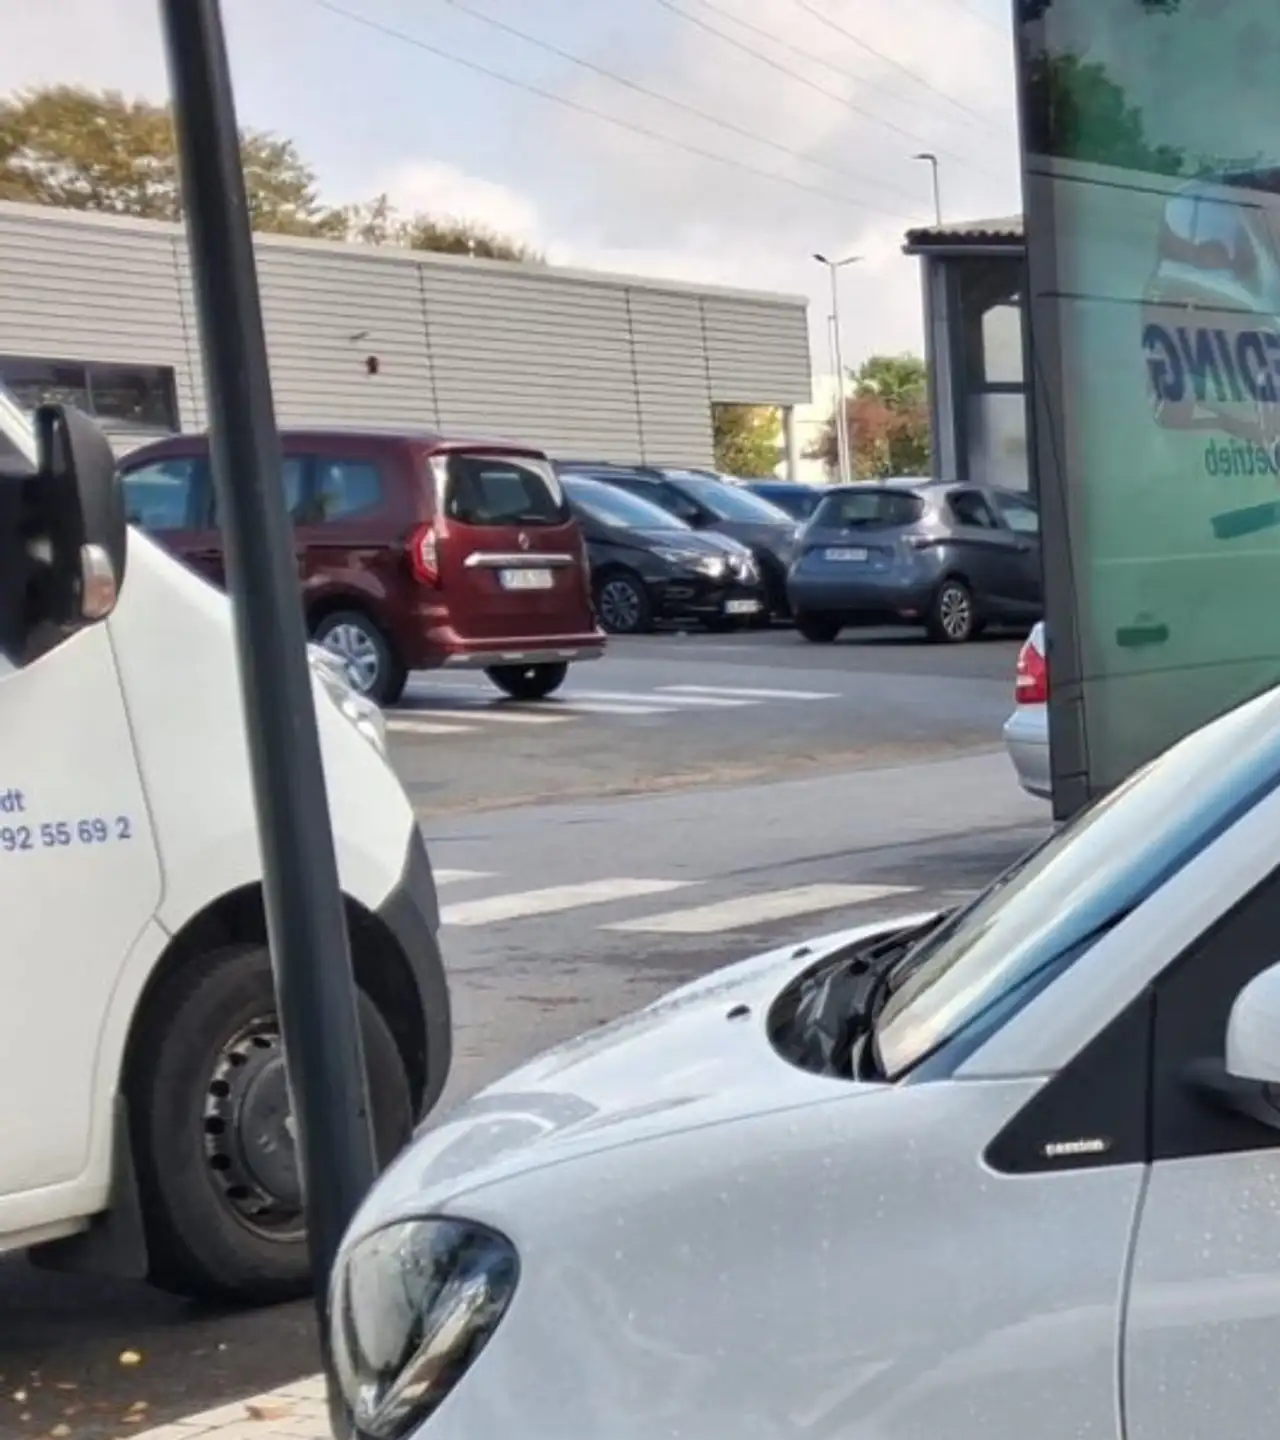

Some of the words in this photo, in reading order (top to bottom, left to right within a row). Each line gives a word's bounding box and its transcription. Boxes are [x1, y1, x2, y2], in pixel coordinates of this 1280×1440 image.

[0, 825, 33, 851] 92
[41, 822, 71, 847] 55
[78, 818, 108, 843] 69
[115, 815, 132, 839] 2
